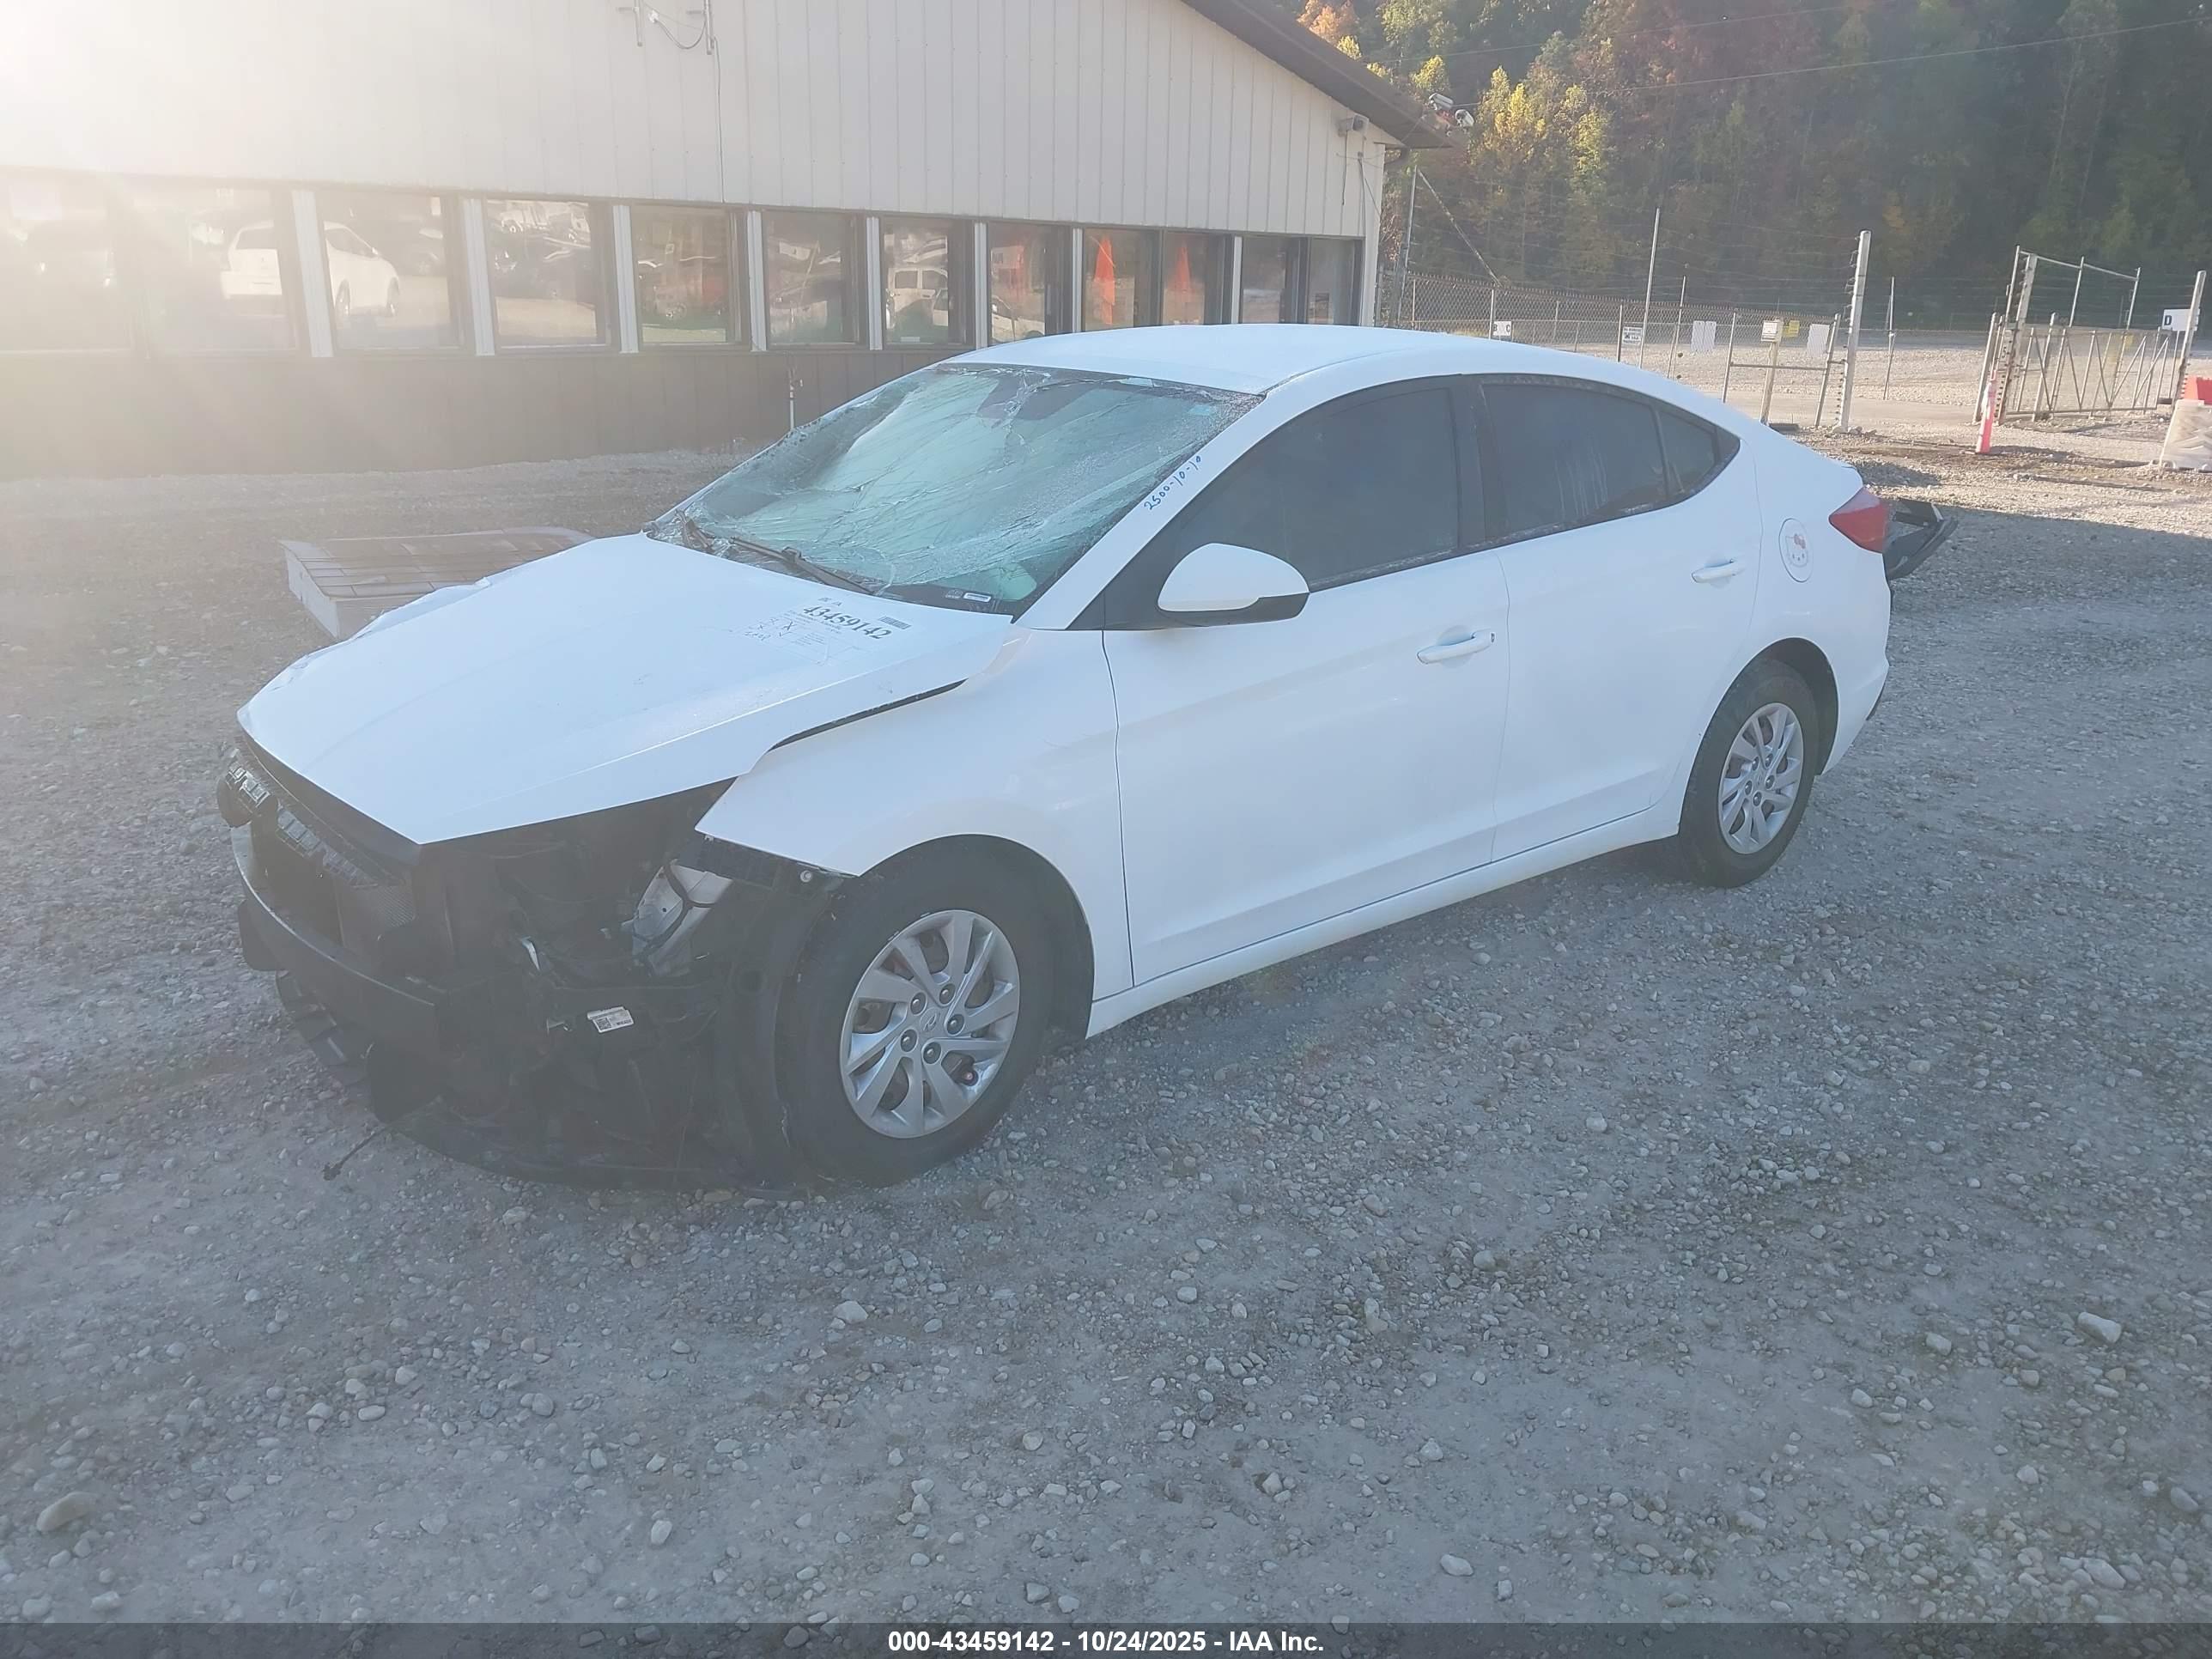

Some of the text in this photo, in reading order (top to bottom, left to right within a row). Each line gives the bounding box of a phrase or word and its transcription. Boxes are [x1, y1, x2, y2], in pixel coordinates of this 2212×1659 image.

[2164, 314, 2172, 326] D
[1505, 324, 1511, 333] C
[803, 605, 892, 639] 43459142
